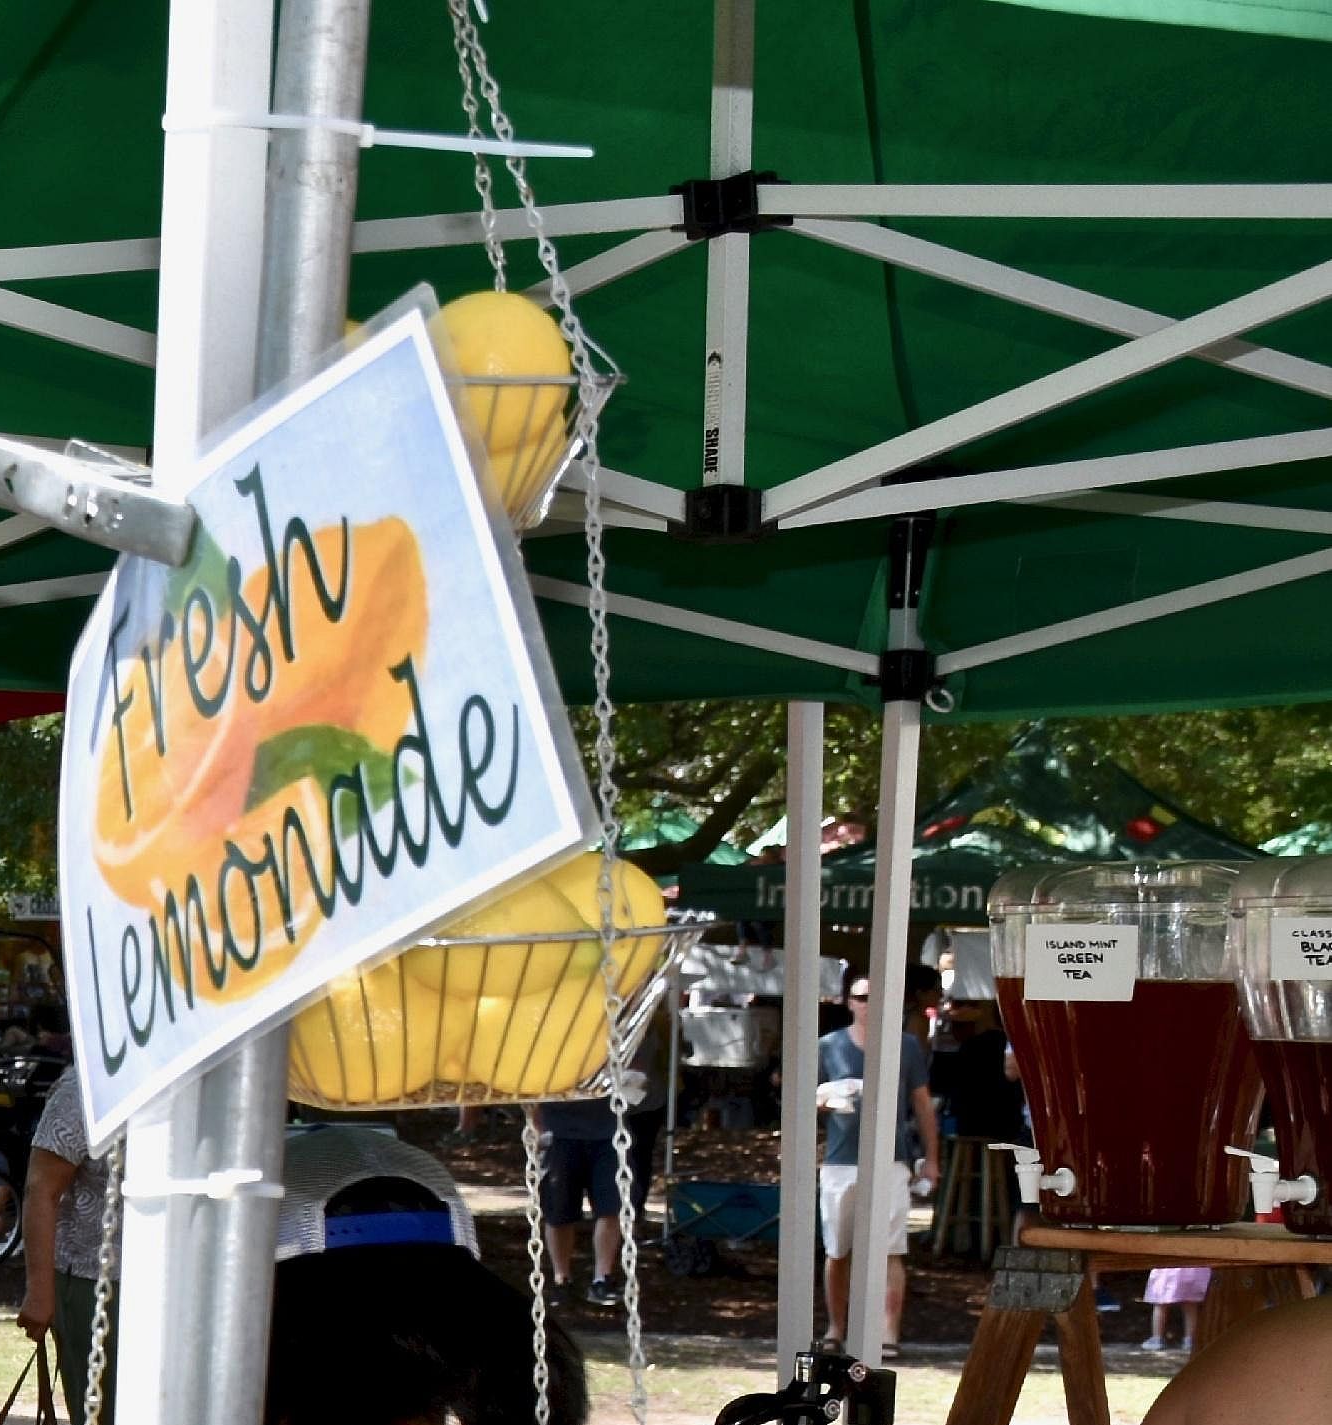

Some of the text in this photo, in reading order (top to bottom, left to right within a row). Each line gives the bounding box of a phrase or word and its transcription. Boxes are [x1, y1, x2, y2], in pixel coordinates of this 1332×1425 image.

[109, 461, 349, 823] Fresh
[86, 654, 520, 1077] Lemonade
[1045, 939, 1118, 949] ISLAND MINT
[1057, 953, 1104, 964] GREEN
[1062, 969, 1092, 979] TEA
